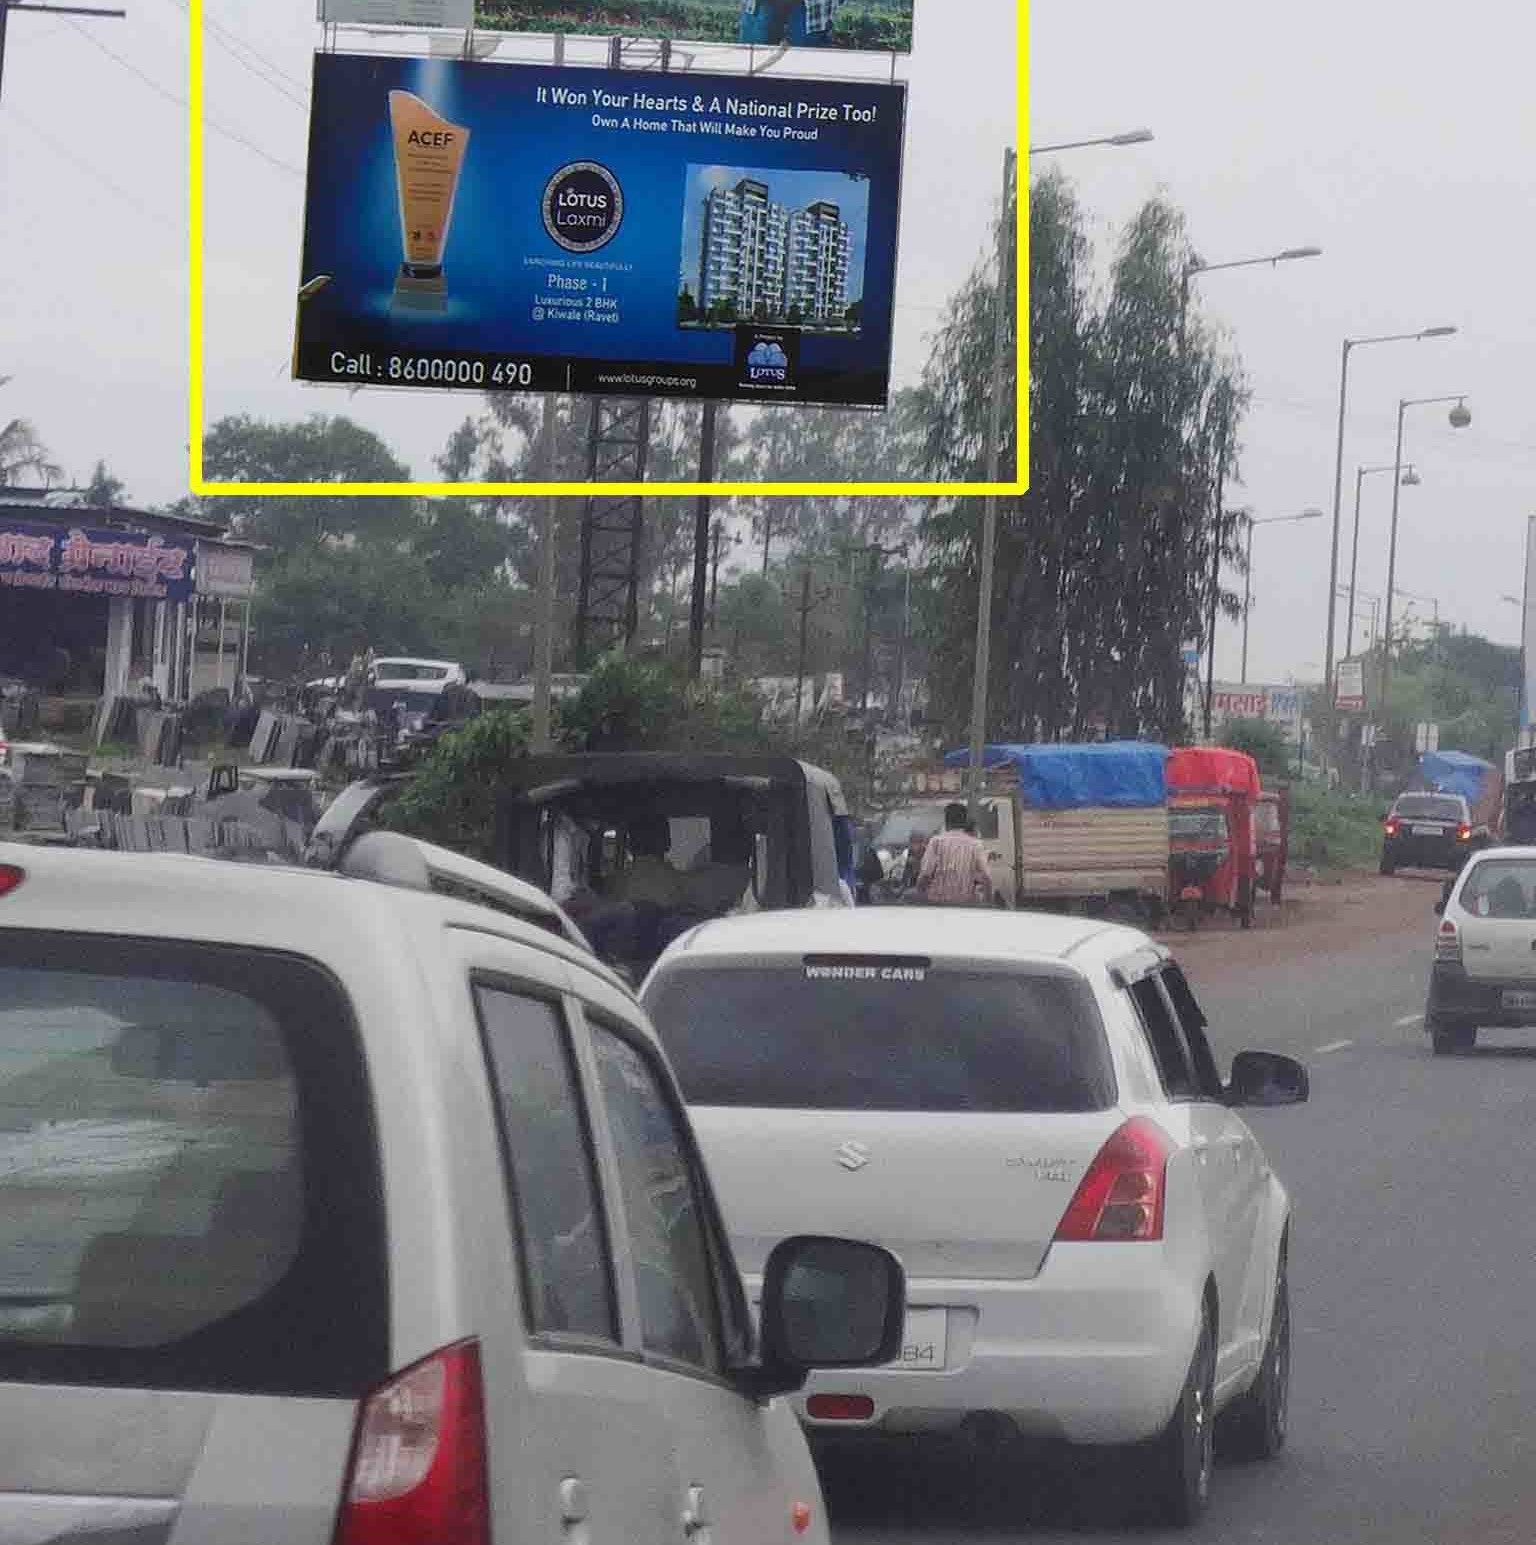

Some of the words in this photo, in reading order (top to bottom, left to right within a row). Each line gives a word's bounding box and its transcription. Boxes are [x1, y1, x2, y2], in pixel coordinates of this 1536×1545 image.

[536, 86, 547, 103] It
[551, 87, 587, 106] Won
[592, 89, 630, 109] Your
[633, 92, 688, 112] Hearts
[692, 95, 705, 113] &
[709, 96, 722, 114] A
[726, 98, 793, 120] National
[796, 102, 839, 122] Prize
[842, 104, 877, 123] Too!
[591, 114, 620, 129] Own
[620, 117, 631, 130] A
[633, 117, 668, 133] Home
[670, 119, 698, 134] That
[699, 121, 722, 136] Will
[724, 122, 757, 139] Make
[759, 125, 781, 140] You
[783, 126, 819, 142] Proud
[407, 130, 456, 146] ACEF
[558, 192, 608, 209] LOTUS
[557, 210, 607, 227] Laxmi
[547, 273, 589, 291] Phase
[534, 294, 584, 306] Luxurious
[586, 296, 594, 306] 2
[595, 297, 618, 309] BHK
[330, 351, 371, 375] Call
[389, 356, 484, 383] 8600000
[491, 362, 532, 385] 490
[750, 367, 785, 380] LOTUS
